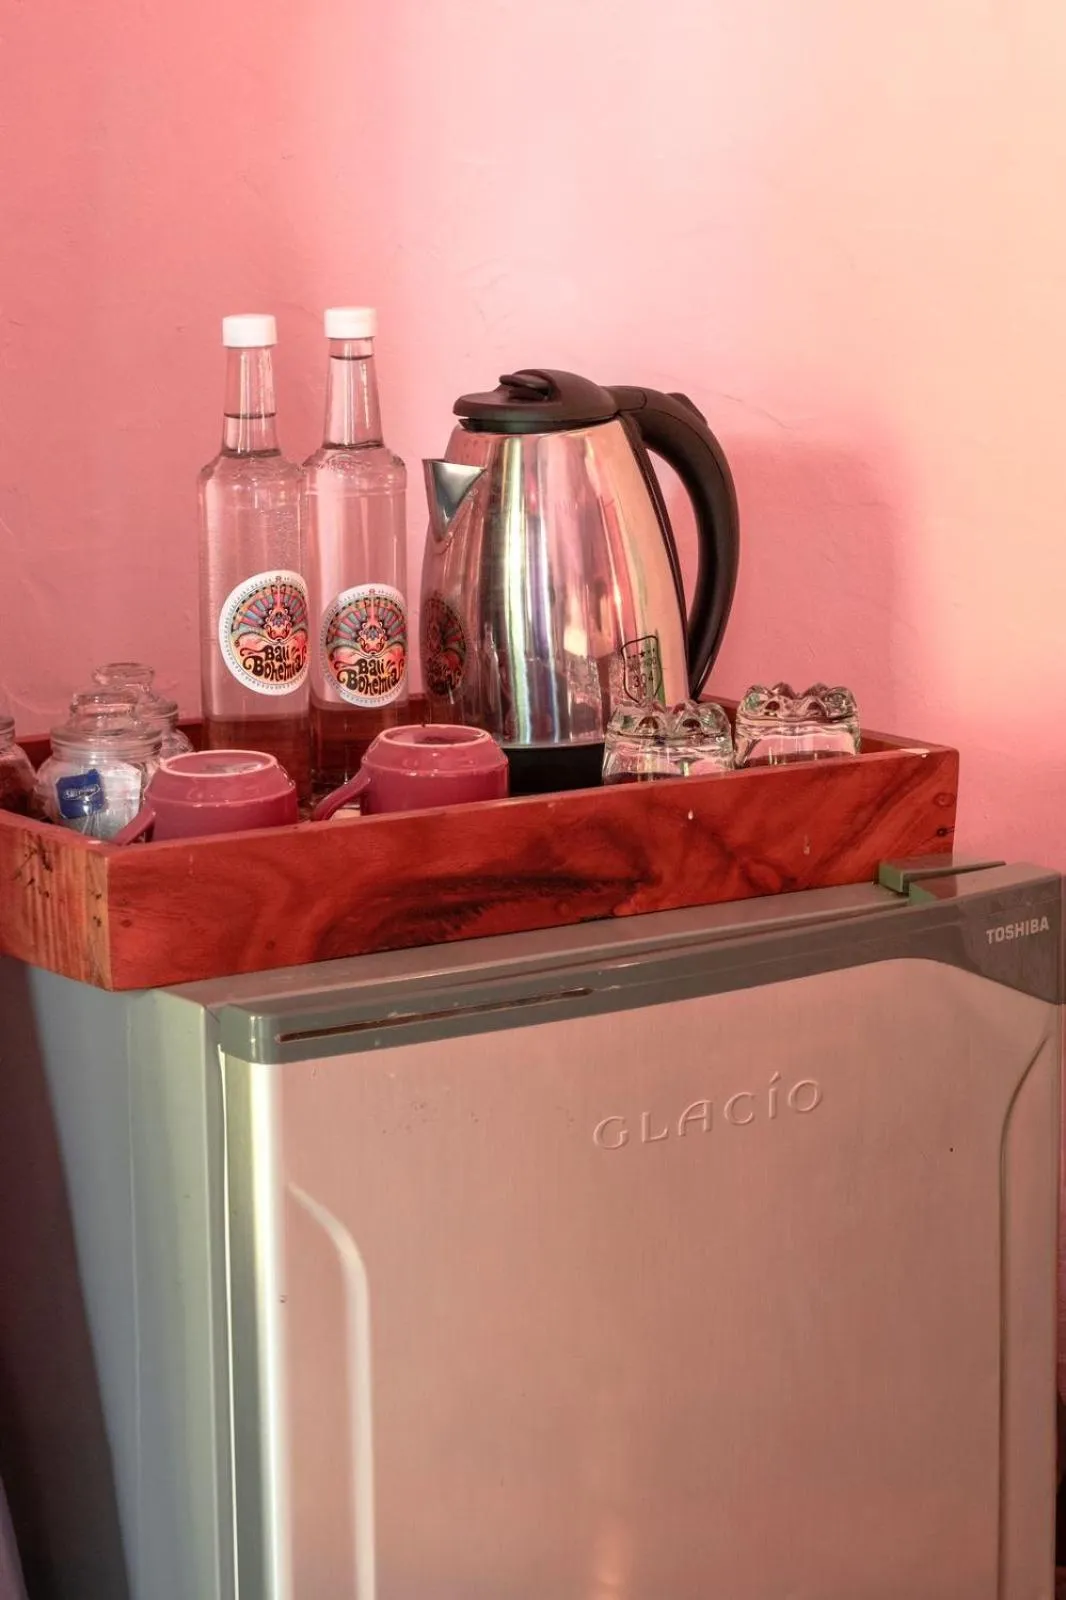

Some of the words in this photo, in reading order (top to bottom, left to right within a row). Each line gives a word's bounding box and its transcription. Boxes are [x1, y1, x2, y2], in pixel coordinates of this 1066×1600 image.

[240, 645, 290, 662] Bali
[243, 646, 307, 682] Bohemia
[334, 658, 385, 676] Bali
[337, 659, 404, 696] Bohemia
[986, 915, 1050, 945] TOSHIBA
